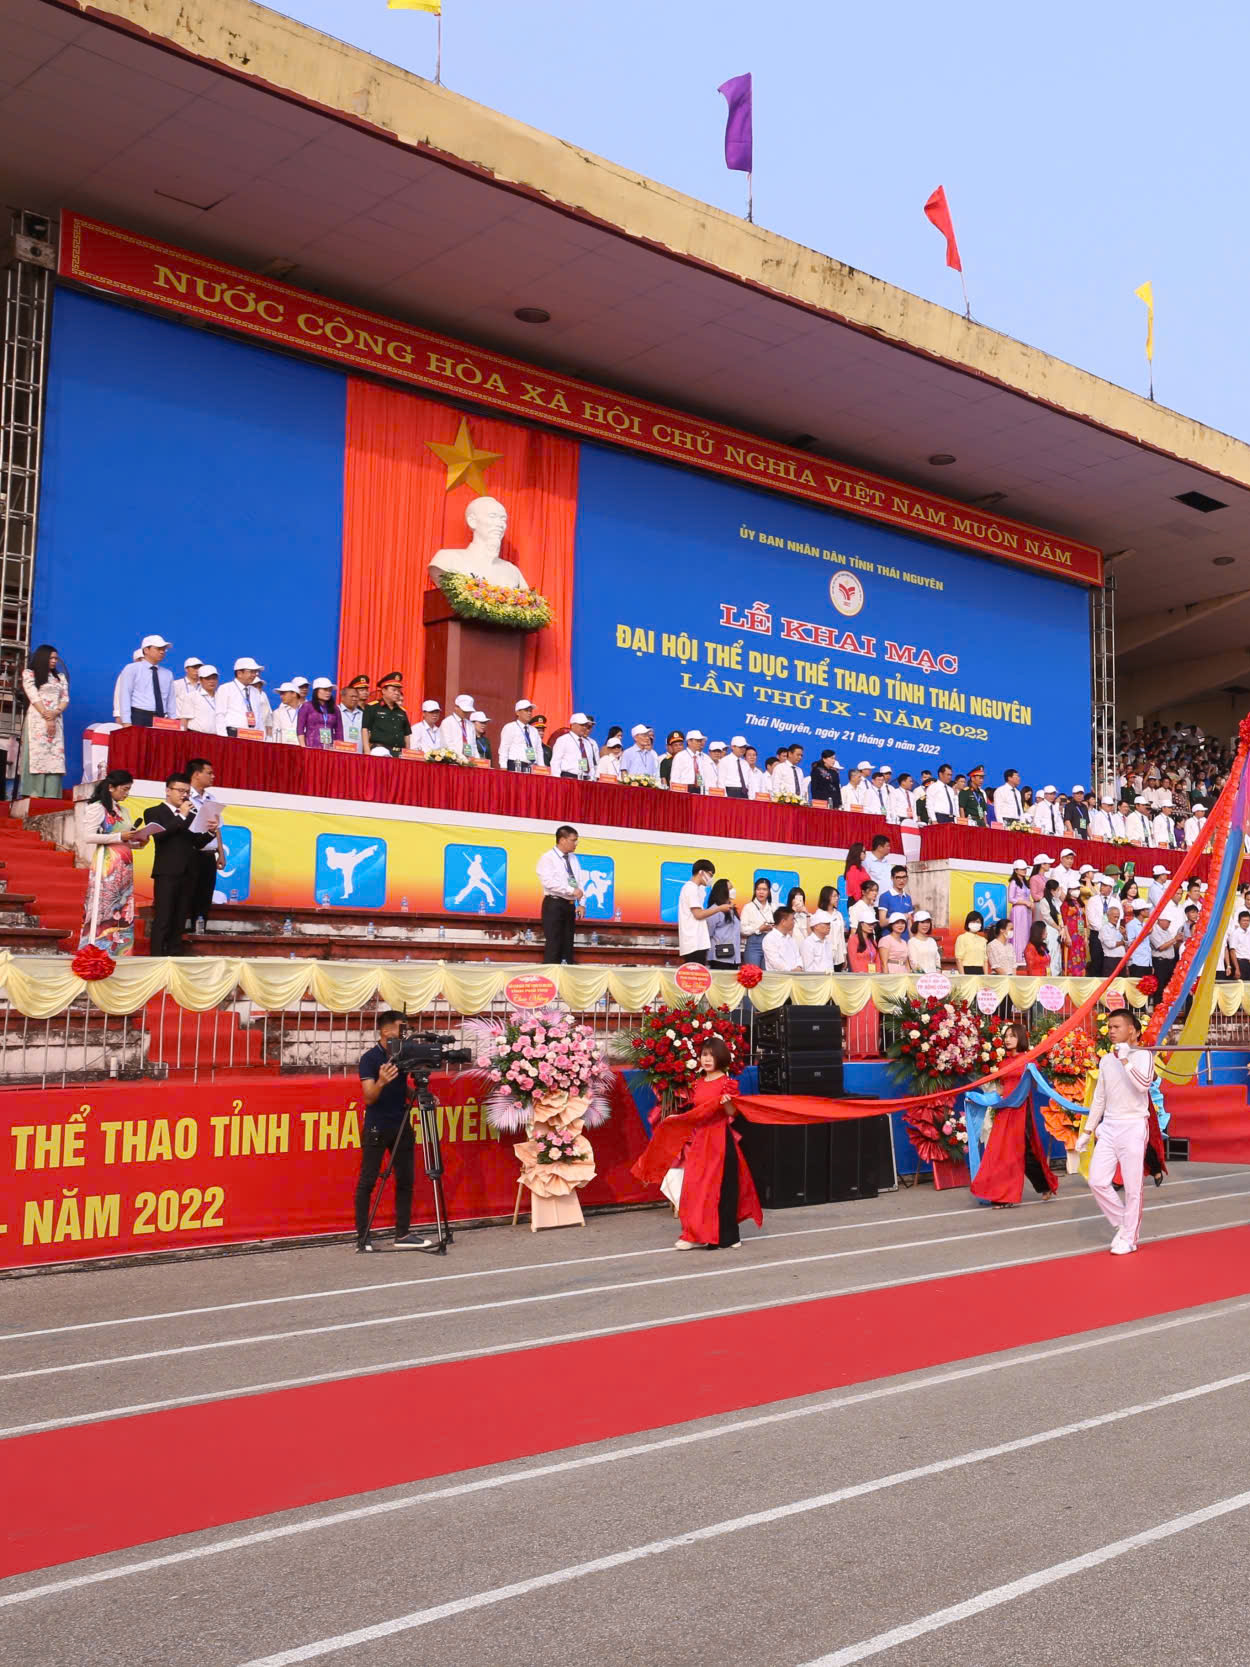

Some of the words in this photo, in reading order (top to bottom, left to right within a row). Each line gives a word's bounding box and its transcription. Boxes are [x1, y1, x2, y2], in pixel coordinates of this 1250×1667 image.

[153, 264, 285, 323] NƯỚC
[297, 313, 415, 364] CỘNG
[426, 352, 510, 395] HÒA
[520, 381, 571, 414] XÃ
[581, 400, 642, 434] HỘI
[652, 424, 715, 455] CHỦ
[724, 444, 817, 487] NGHĨA
[825, 476, 885, 506] VIỆT
[891, 496, 947, 527] NAM
[952, 514, 1019, 549] MUÔN
[1023, 538, 1073, 566] NĂM
[739, 524, 756, 540] ỦY
[759, 532, 784, 548] BAN
[787, 540, 820, 558] NHÂN
[823, 550, 846, 565] DÂN
[849, 555, 874, 573] TỈNH
[876, 565, 901, 580] THÁI
[902, 571, 944, 591] NGUYÊN
[720, 601, 772, 635] LỄ
[780, 617, 876, 658] KHAI
[885, 641, 958, 674] MẠC
[616, 624, 655, 656] ĐẠI
[662, 632, 698, 665] HỘI
[704, 639, 744, 671] THỂ
[748, 650, 788, 681] DỤC
[794, 657, 830, 687] THỂ
[834, 667, 880, 696] THAO
[885, 673, 925, 705] TỈNH
[929, 688, 966, 712] THÁI
[970, 695, 1032, 725] NGUYÊN
[680, 670, 745, 698] LẦN
[753, 686, 814, 710] THỨ
[819, 698, 851, 717] IX
[873, 708, 933, 731] NĂM
[939, 721, 989, 741] 2022
[745, 713, 768, 728] Thái
[770, 718, 812, 735] Nguyên,
[815, 727, 840, 741] ngày
[841, 730, 855, 741] 21
[857, 733, 885, 748] tháng
[886, 737, 894, 747] 9
[895, 739, 916, 751] năm
[917, 743, 941, 755] 2022
[11, 1104, 91, 1171] THỂ
[100, 1117, 198, 1165] THAO
[210, 1099, 290, 1157] TỈNH
[300, 1103, 367, 1152] THÁ
[409, 1097, 499, 1144] GUYÊN
[23, 1187, 121, 1246] NĂM
[133, 1186, 225, 1235] 2022
